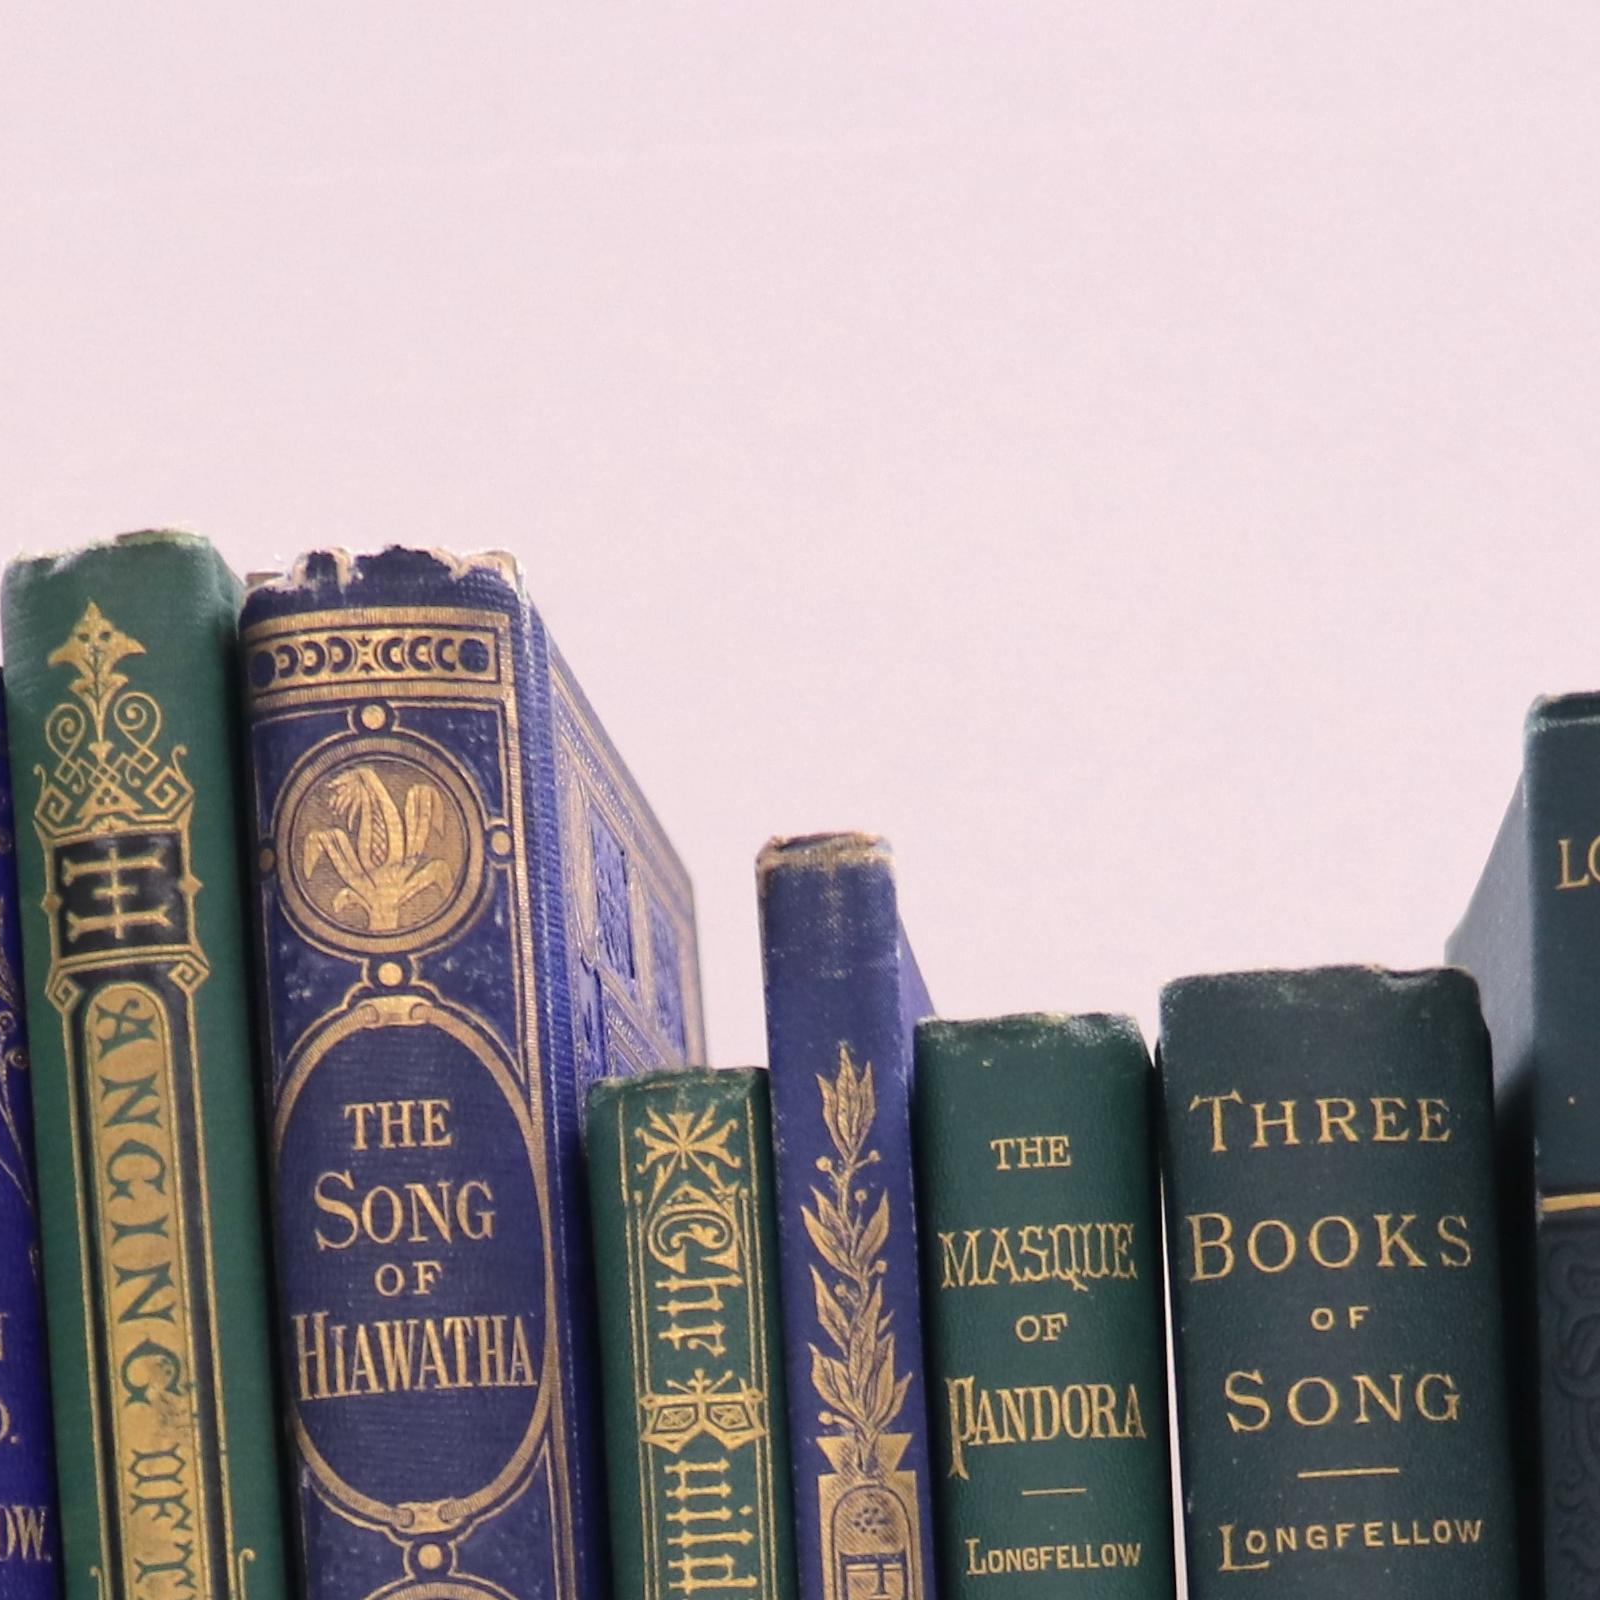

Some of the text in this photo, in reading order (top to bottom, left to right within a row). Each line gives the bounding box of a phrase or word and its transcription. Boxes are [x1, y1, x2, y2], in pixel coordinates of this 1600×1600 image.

[345, 1099, 452, 1151] THE
[990, 1135, 1072, 1169] THE
[1188, 1090, 1451, 1153] THREE
[313, 1171, 496, 1251] SONG
[647, 1193, 745, 1357] The
[937, 1222, 1138, 1291] MASQUE
[1185, 1212, 1472, 1282] BOOKS
[375, 1261, 443, 1297] OF
[1015, 1313, 1068, 1342] OF
[1310, 1305, 1370, 1333] OF
[291, 1310, 538, 1403] HIAWATHA
[945, 1375, 1147, 1480] PANDORA
[1223, 1370, 1461, 1433] SONG
[127, 1446, 192, 1533] OF
[965, 1537, 1142, 1577] LONGFELLOW
[1218, 1518, 1484, 1572] LONGFELLOW
